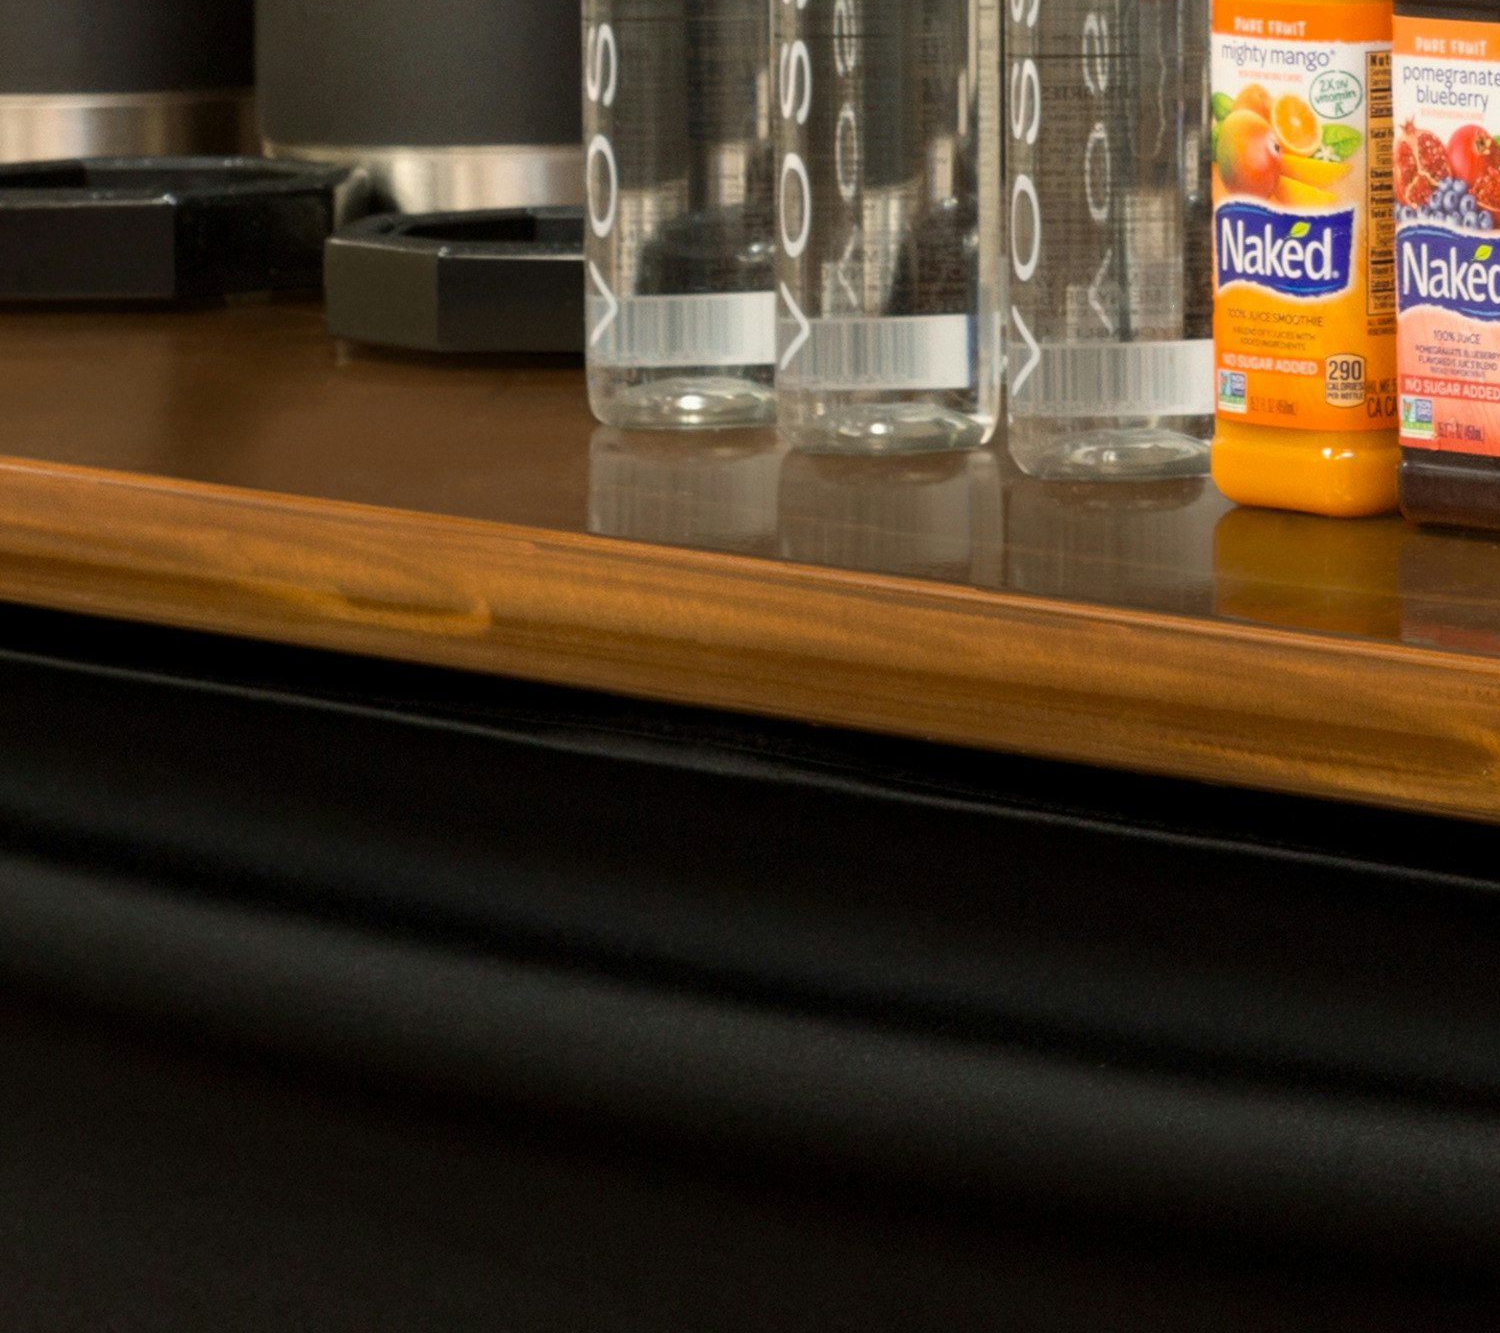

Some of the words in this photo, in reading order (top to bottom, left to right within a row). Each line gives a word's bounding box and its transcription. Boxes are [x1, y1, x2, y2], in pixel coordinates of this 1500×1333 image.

[1233, 16, 1264, 35] PURE
[1268, 20, 1307, 37] FRUIT
[1221, 41, 1267, 67] mighty
[1415, 37, 1446, 53] PURE
[1451, 39, 1488, 56] FRUIT
[1416, 84, 1489, 112] blueberry
[1221, 217, 1333, 281] Naked
[1273, 311, 1324, 327] SMOOTHIE
[1457, 332, 1481, 345] JUICE
[1237, 355, 1274, 370] SUGAR
[1275, 360, 1318, 375] ADDED
[1328, 359, 1362, 381] 290
[1404, 377, 1422, 392] NO
[1423, 379, 1461, 396] SUGAR
